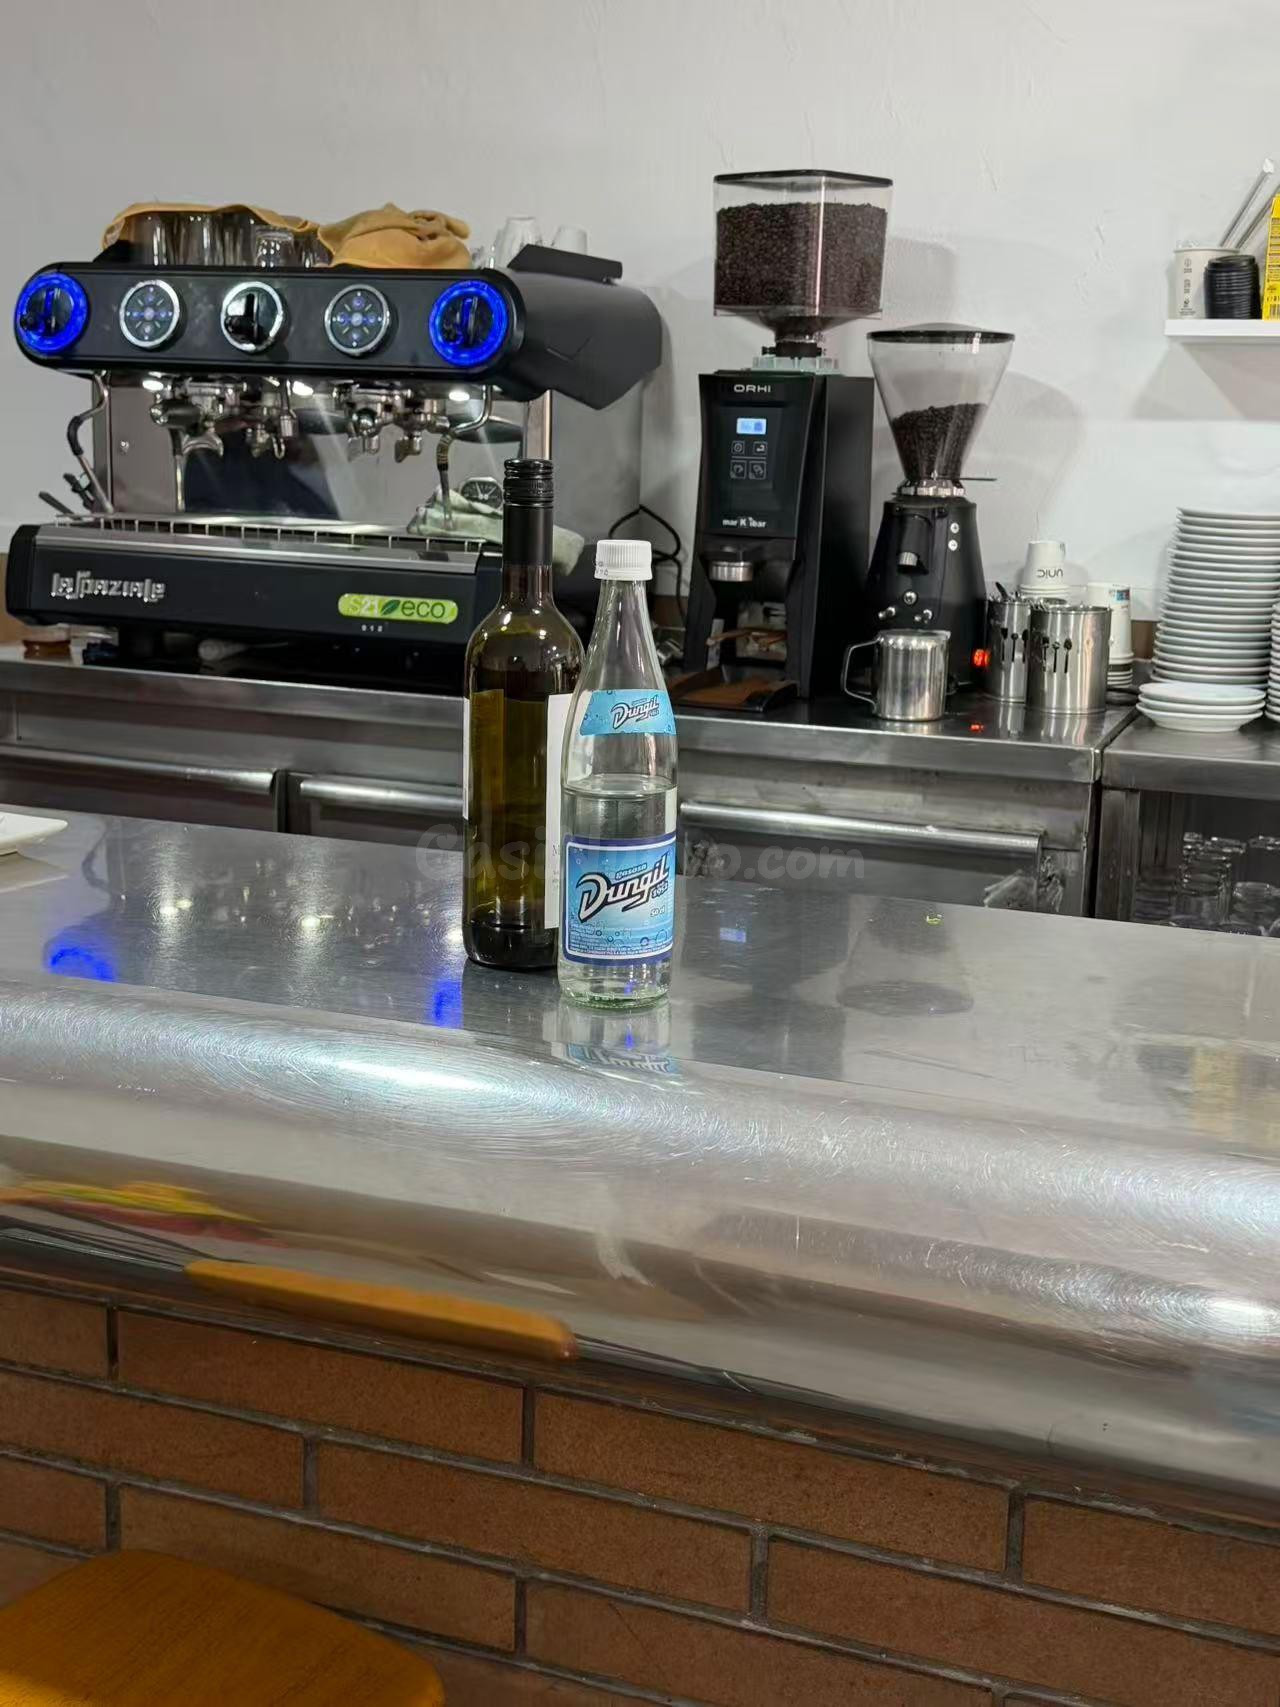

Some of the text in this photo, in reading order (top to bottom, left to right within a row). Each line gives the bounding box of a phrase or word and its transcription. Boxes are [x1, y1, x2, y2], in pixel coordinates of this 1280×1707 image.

[733, 384, 771, 393] ORHI
[400, 600, 446, 618] eco
[611, 694, 660, 730] Dungil
[576, 851, 670, 923] Dungil
